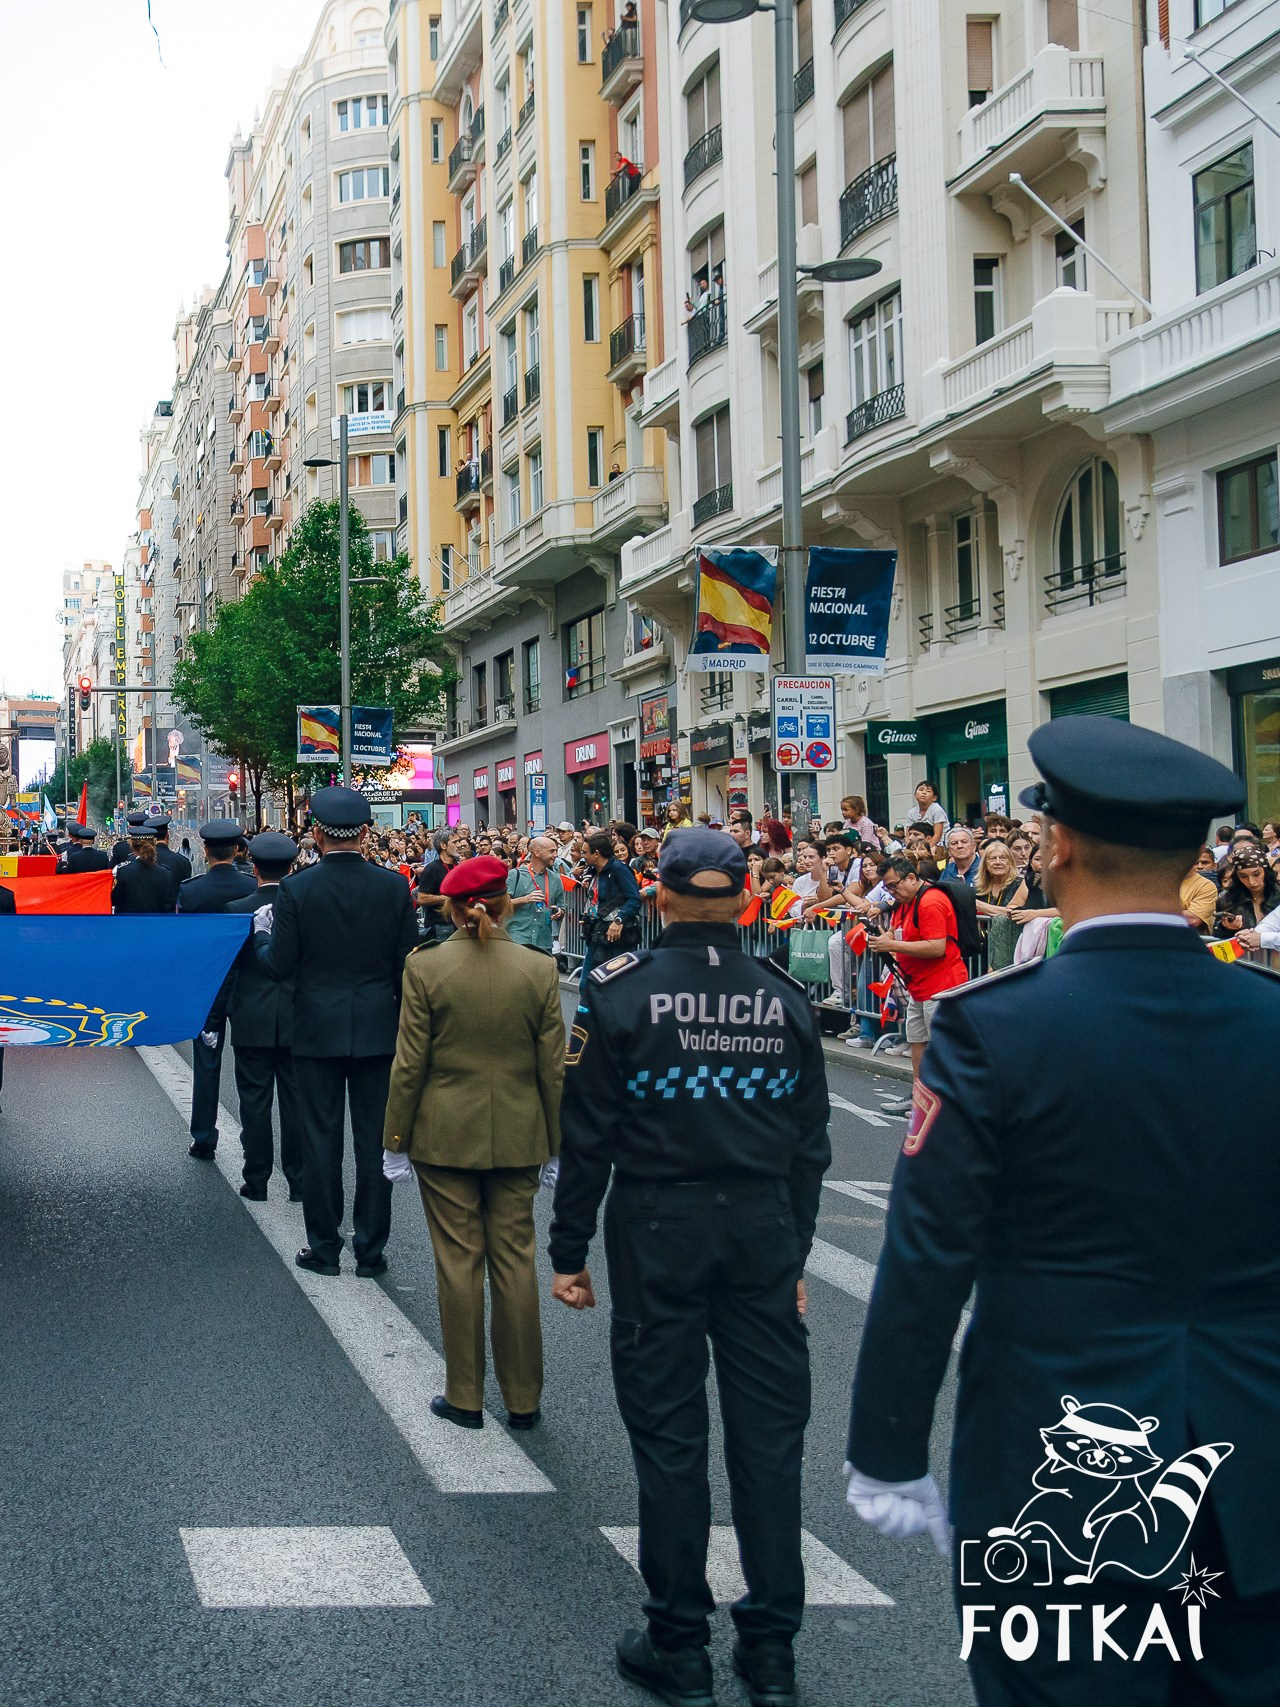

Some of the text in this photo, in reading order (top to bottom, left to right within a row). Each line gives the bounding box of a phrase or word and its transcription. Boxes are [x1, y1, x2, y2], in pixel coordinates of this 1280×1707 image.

[811, 586, 846, 599] FIESTA
[115, 575, 125, 640] HOTEL
[809, 602, 868, 616] NACIONAL
[808, 633, 876, 650] 12 OCTUBRE
[708, 659, 747, 670] MADRID
[777, 678, 831, 689] PRECAUCIÓN
[354, 723, 372, 731] FIESTA
[354, 730, 383, 738] NACIONAL
[621, 725, 630, 739] 61
[964, 720, 990, 740] Ginos
[877, 728, 917, 744] Ginos
[359, 744, 387, 754] OCTUBRE
[575, 743, 597, 763] DRUNI
[649, 989, 785, 1026] POLICÍA
[678, 1028, 784, 1054] Valdemoro
